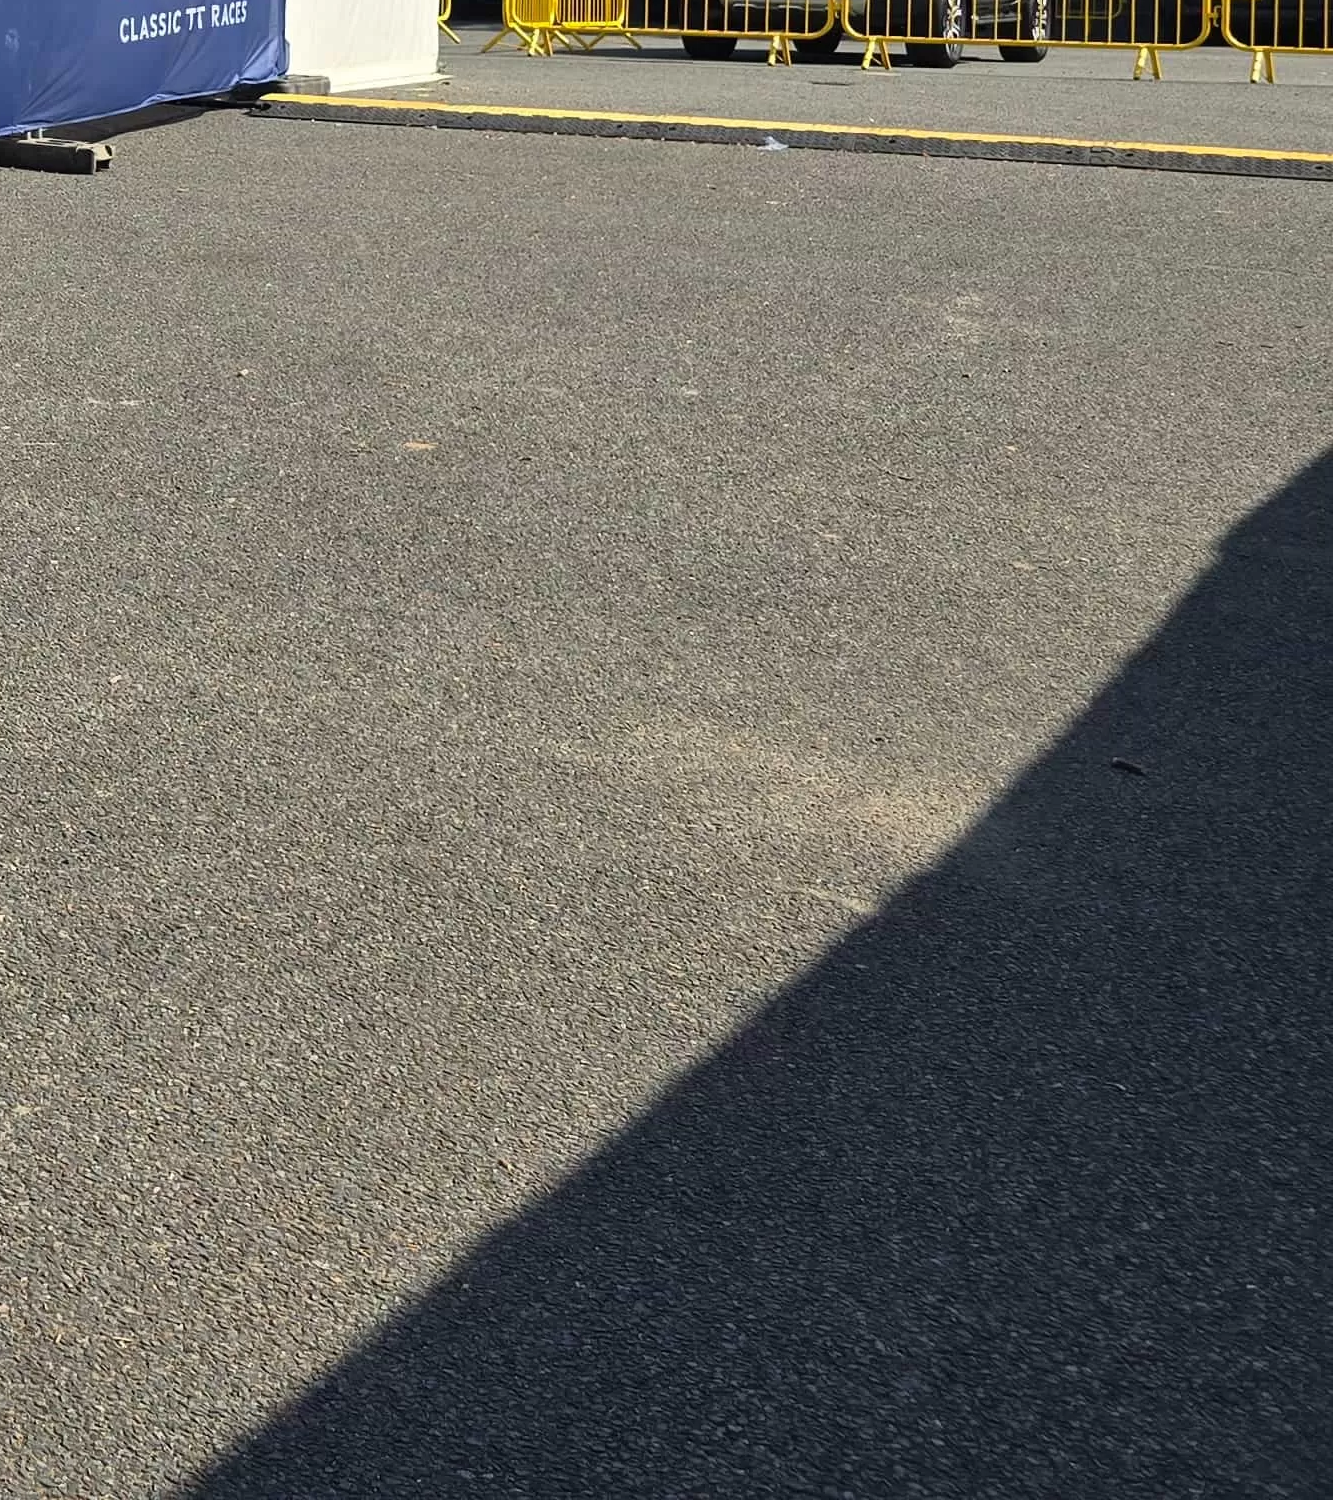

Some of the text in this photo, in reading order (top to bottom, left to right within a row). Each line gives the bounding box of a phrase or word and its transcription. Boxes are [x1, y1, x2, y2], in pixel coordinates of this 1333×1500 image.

[119, 0, 248, 43] CLASSIC TT RACES
